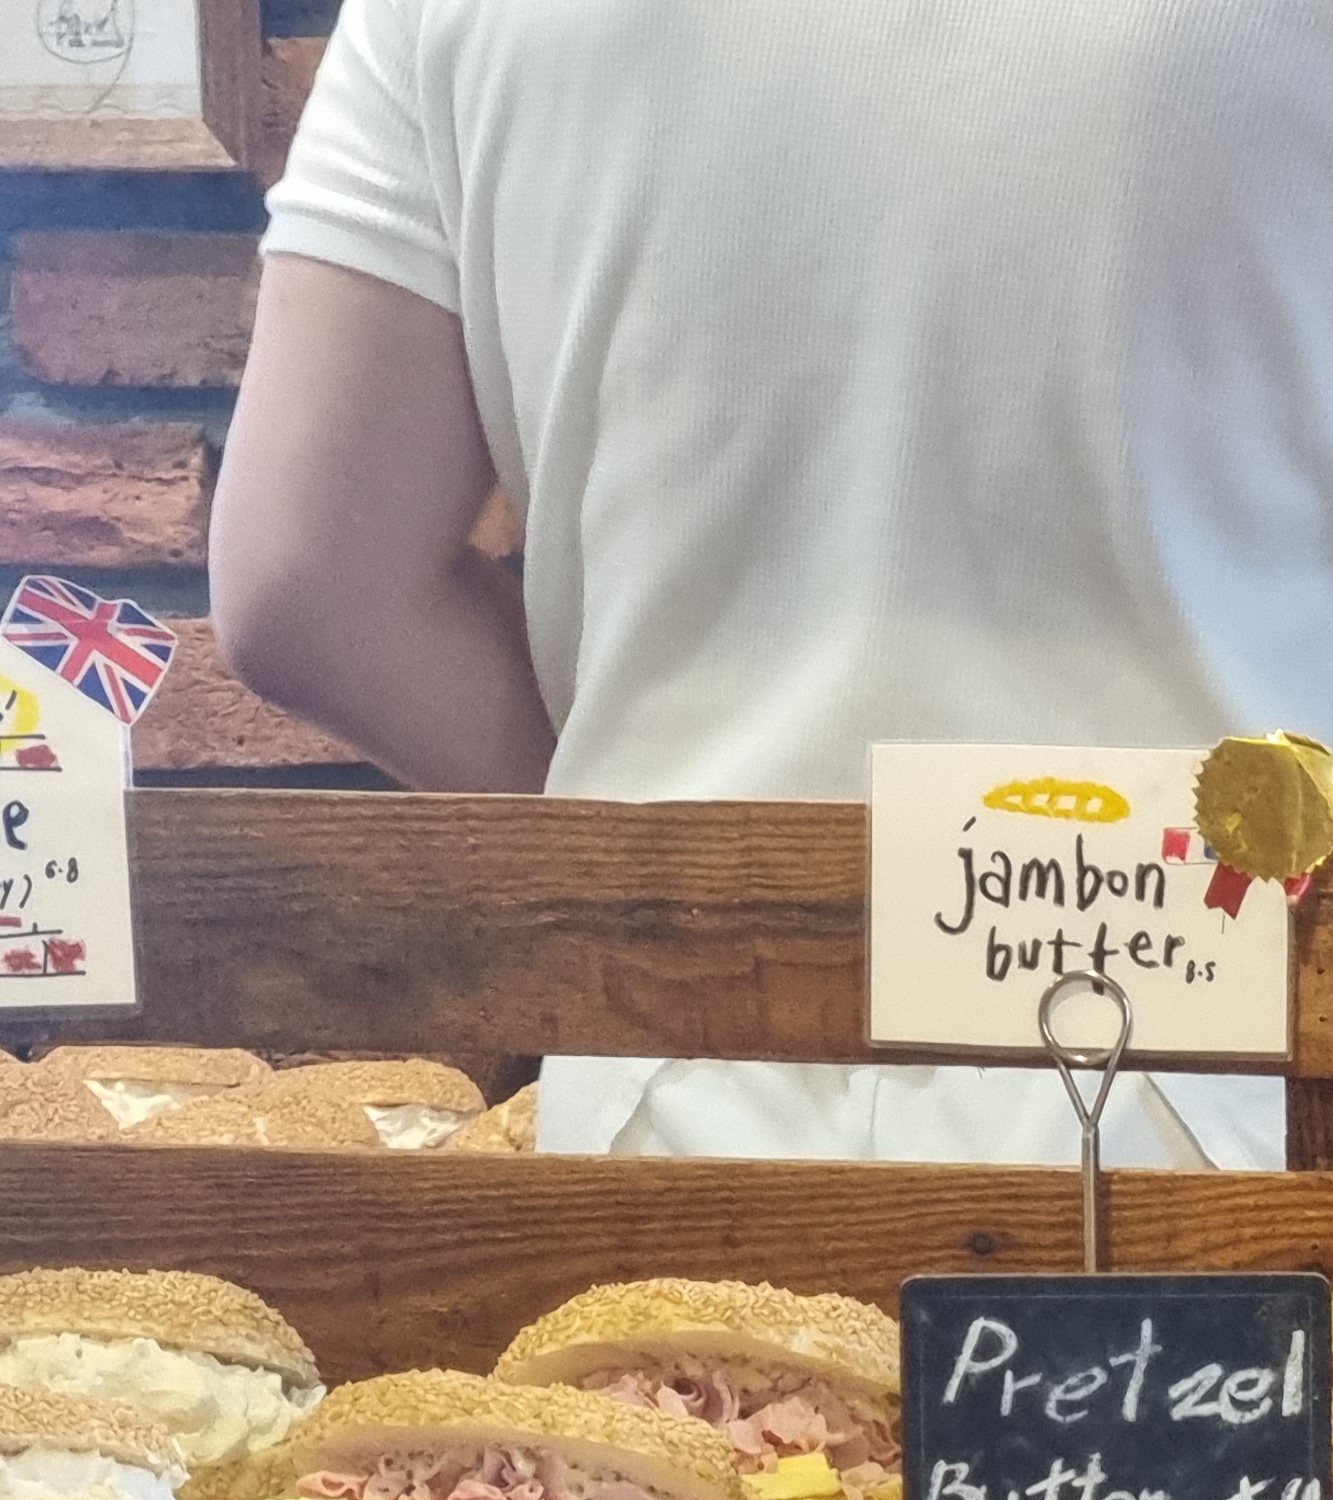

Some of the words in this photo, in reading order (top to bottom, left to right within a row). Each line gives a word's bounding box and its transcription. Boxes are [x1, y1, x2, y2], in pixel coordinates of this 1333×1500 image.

[935, 817, 1166, 935] jambon
[986, 922, 1185, 995] butter
[943, 1317, 1305, 1424] Pretzel
